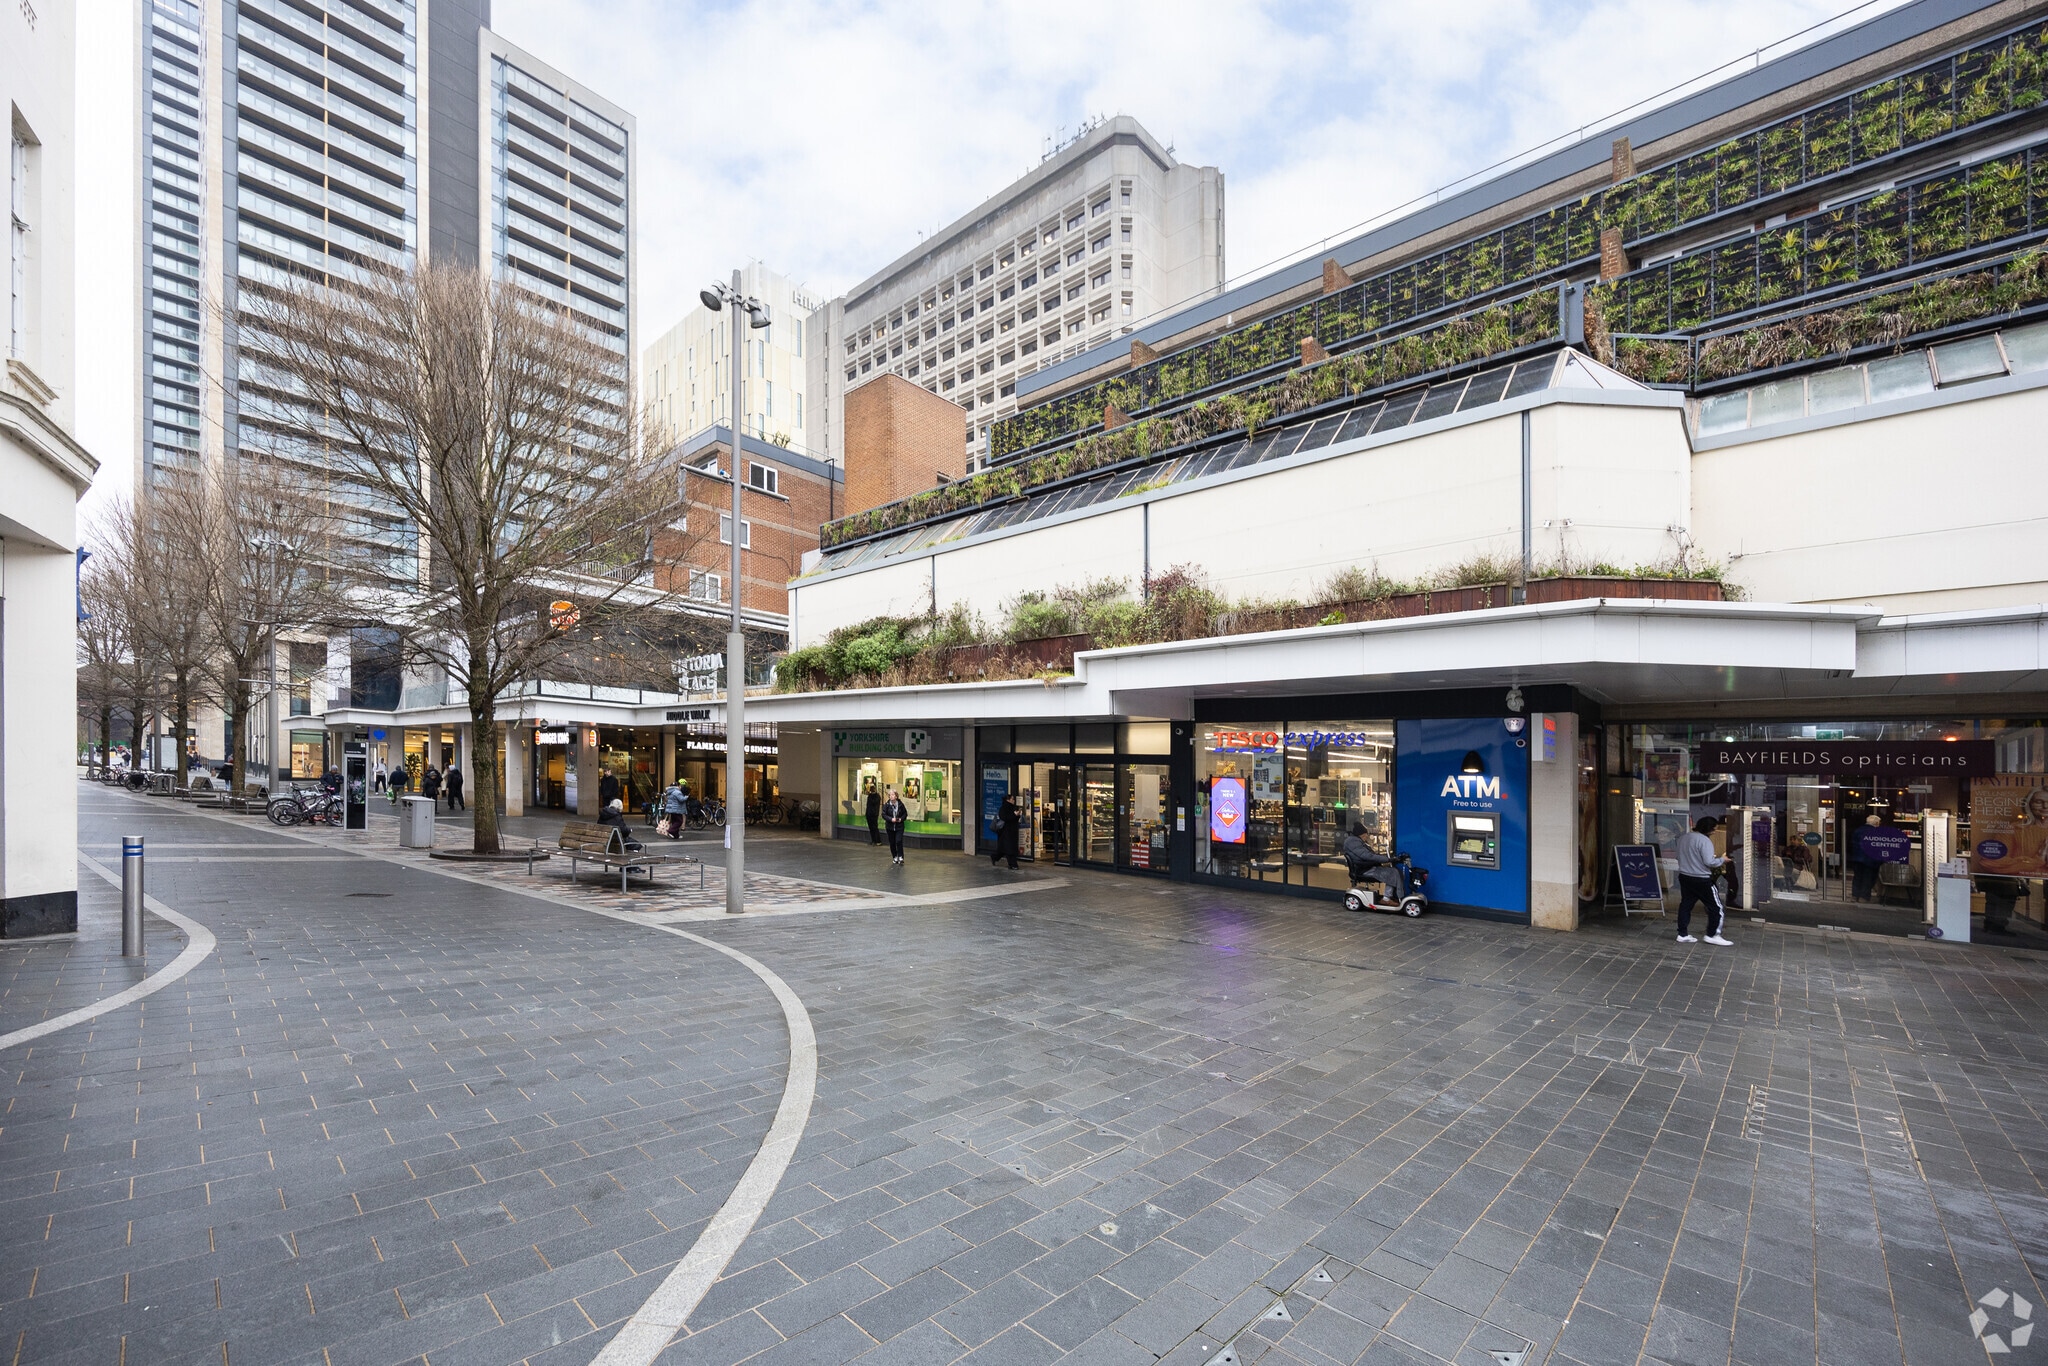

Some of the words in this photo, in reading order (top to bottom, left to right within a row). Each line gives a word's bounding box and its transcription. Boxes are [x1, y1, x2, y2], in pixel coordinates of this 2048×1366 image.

[849, 732, 890, 742] YORKSHIRE
[1213, 731, 1279, 747] TESCO
[1283, 729, 1366, 751] express
[687, 740, 714, 751] FLAME
[849, 743, 881, 753] BUILDING
[883, 743, 906, 753] SOCIE
[1719, 751, 1831, 765] BAYFIELDS
[1841, 752, 1968, 769] opticians
[1974, 797, 2028, 808] BEGINS
[1974, 807, 2013, 817] HERE
